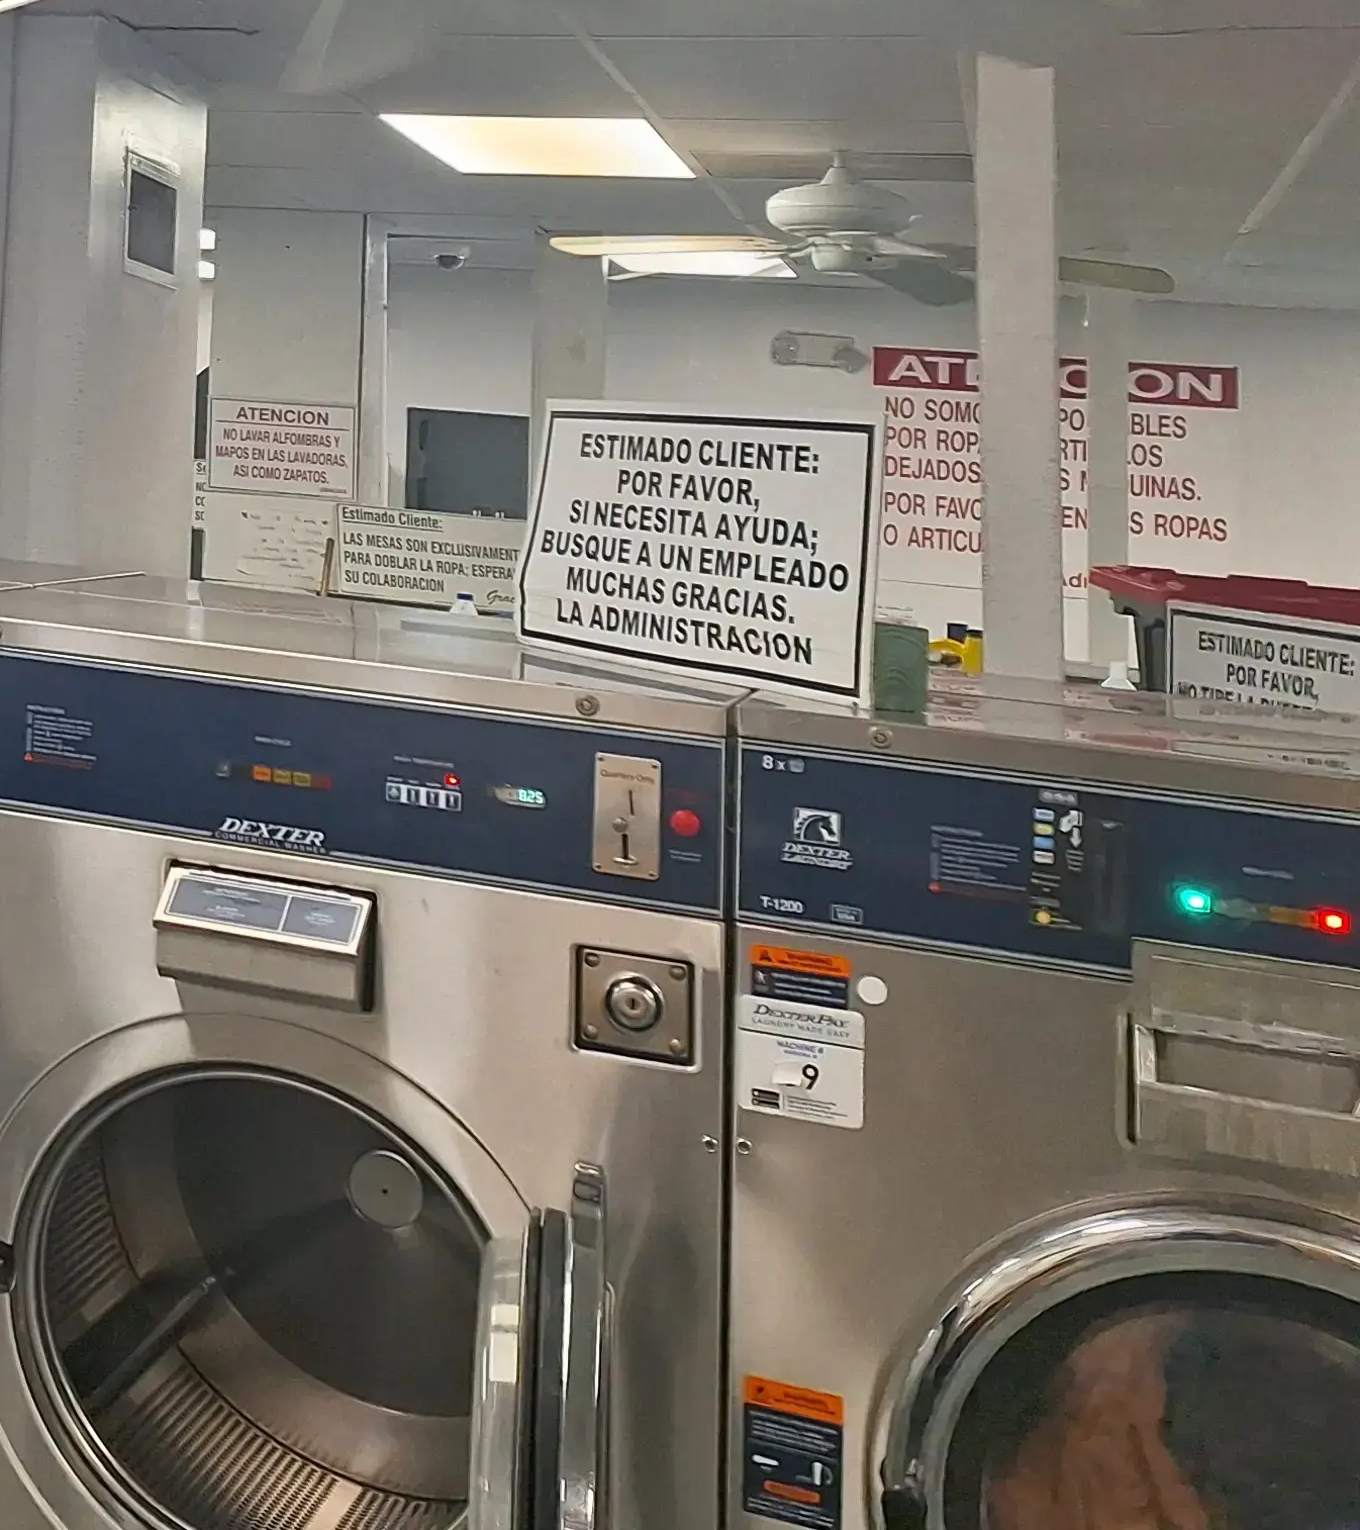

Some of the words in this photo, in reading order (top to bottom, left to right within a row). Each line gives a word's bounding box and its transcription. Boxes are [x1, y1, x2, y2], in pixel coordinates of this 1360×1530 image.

[236, 407, 329, 426] ATENCION
[885, 397, 915, 419] NO
[223, 428, 237, 441] NO
[240, 429, 271, 444] LAVAR
[273, 432, 331, 447] ALFOMBRAS
[334, 436, 341, 448] Y
[884, 426, 927, 451] POR
[216, 445, 249, 460] MAPOS
[252, 448, 265, 461] EN
[268, 449, 285, 463] LAS
[288, 452, 348, 469] LAVADORAS,
[580, 433, 692, 464] ESTIMADO
[698, 439, 820, 474] CLIENTE:
[233, 464, 249, 477] ASI
[252, 466, 280, 480] COMO
[283, 468, 330, 484] ZAPATOS.
[884, 455, 980, 484] DEJADOS
[617, 469, 662, 498] POR
[669, 474, 760, 512] FAVOR,
[342, 507, 395, 525] Estimado
[399, 512, 443, 529] Cliente:
[569, 499, 589, 525] SI
[593, 500, 708, 539] NECESITA
[714, 513, 819, 556] AYUDA;
[884, 492, 925, 516] POR
[1155, 514, 1227, 542] ROPAS
[343, 532, 362, 547] LAS
[366, 535, 402, 551] MESAS
[406, 538, 428, 553] SON
[431, 541, 520, 562] EXCLUSIVAMENT
[884, 523, 898, 546] O
[908, 526, 980, 553] ARTICU
[344, 550, 371, 567] PARA
[375, 555, 415, 571] DOBLAR
[419, 558, 433, 573] LA
[472, 564, 516, 581] ESPERA
[541, 529, 630, 564] BUSQUE
[636, 541, 652, 568] A
[659, 543, 692, 573] UN
[699, 548, 849, 592] EMPLEADO
[344, 570, 358, 585] SU
[362, 572, 444, 593] COLABORACION
[566, 566, 666, 604] MUCHAS
[672, 581, 795, 624] GRACIAS.
[556, 598, 581, 627] LA
[589, 604, 813, 666] ADMINISTRACION
[1199, 631, 1275, 662] ESTIMADO
[1279, 643, 1356, 677] CLIENTE:
[1226, 663, 1257, 687] POR
[1261, 670, 1320, 704] FAVOR,
[762, 755, 774, 769] 8
[215, 831, 280, 847] COMMERCIAL
[284, 842, 327, 854] WASHER
[219, 817, 325, 847] DEXTER
[782, 842, 853, 860] DEXTER
[760, 895, 804, 913] T-1200
[802, 1064, 819, 1090] 9
